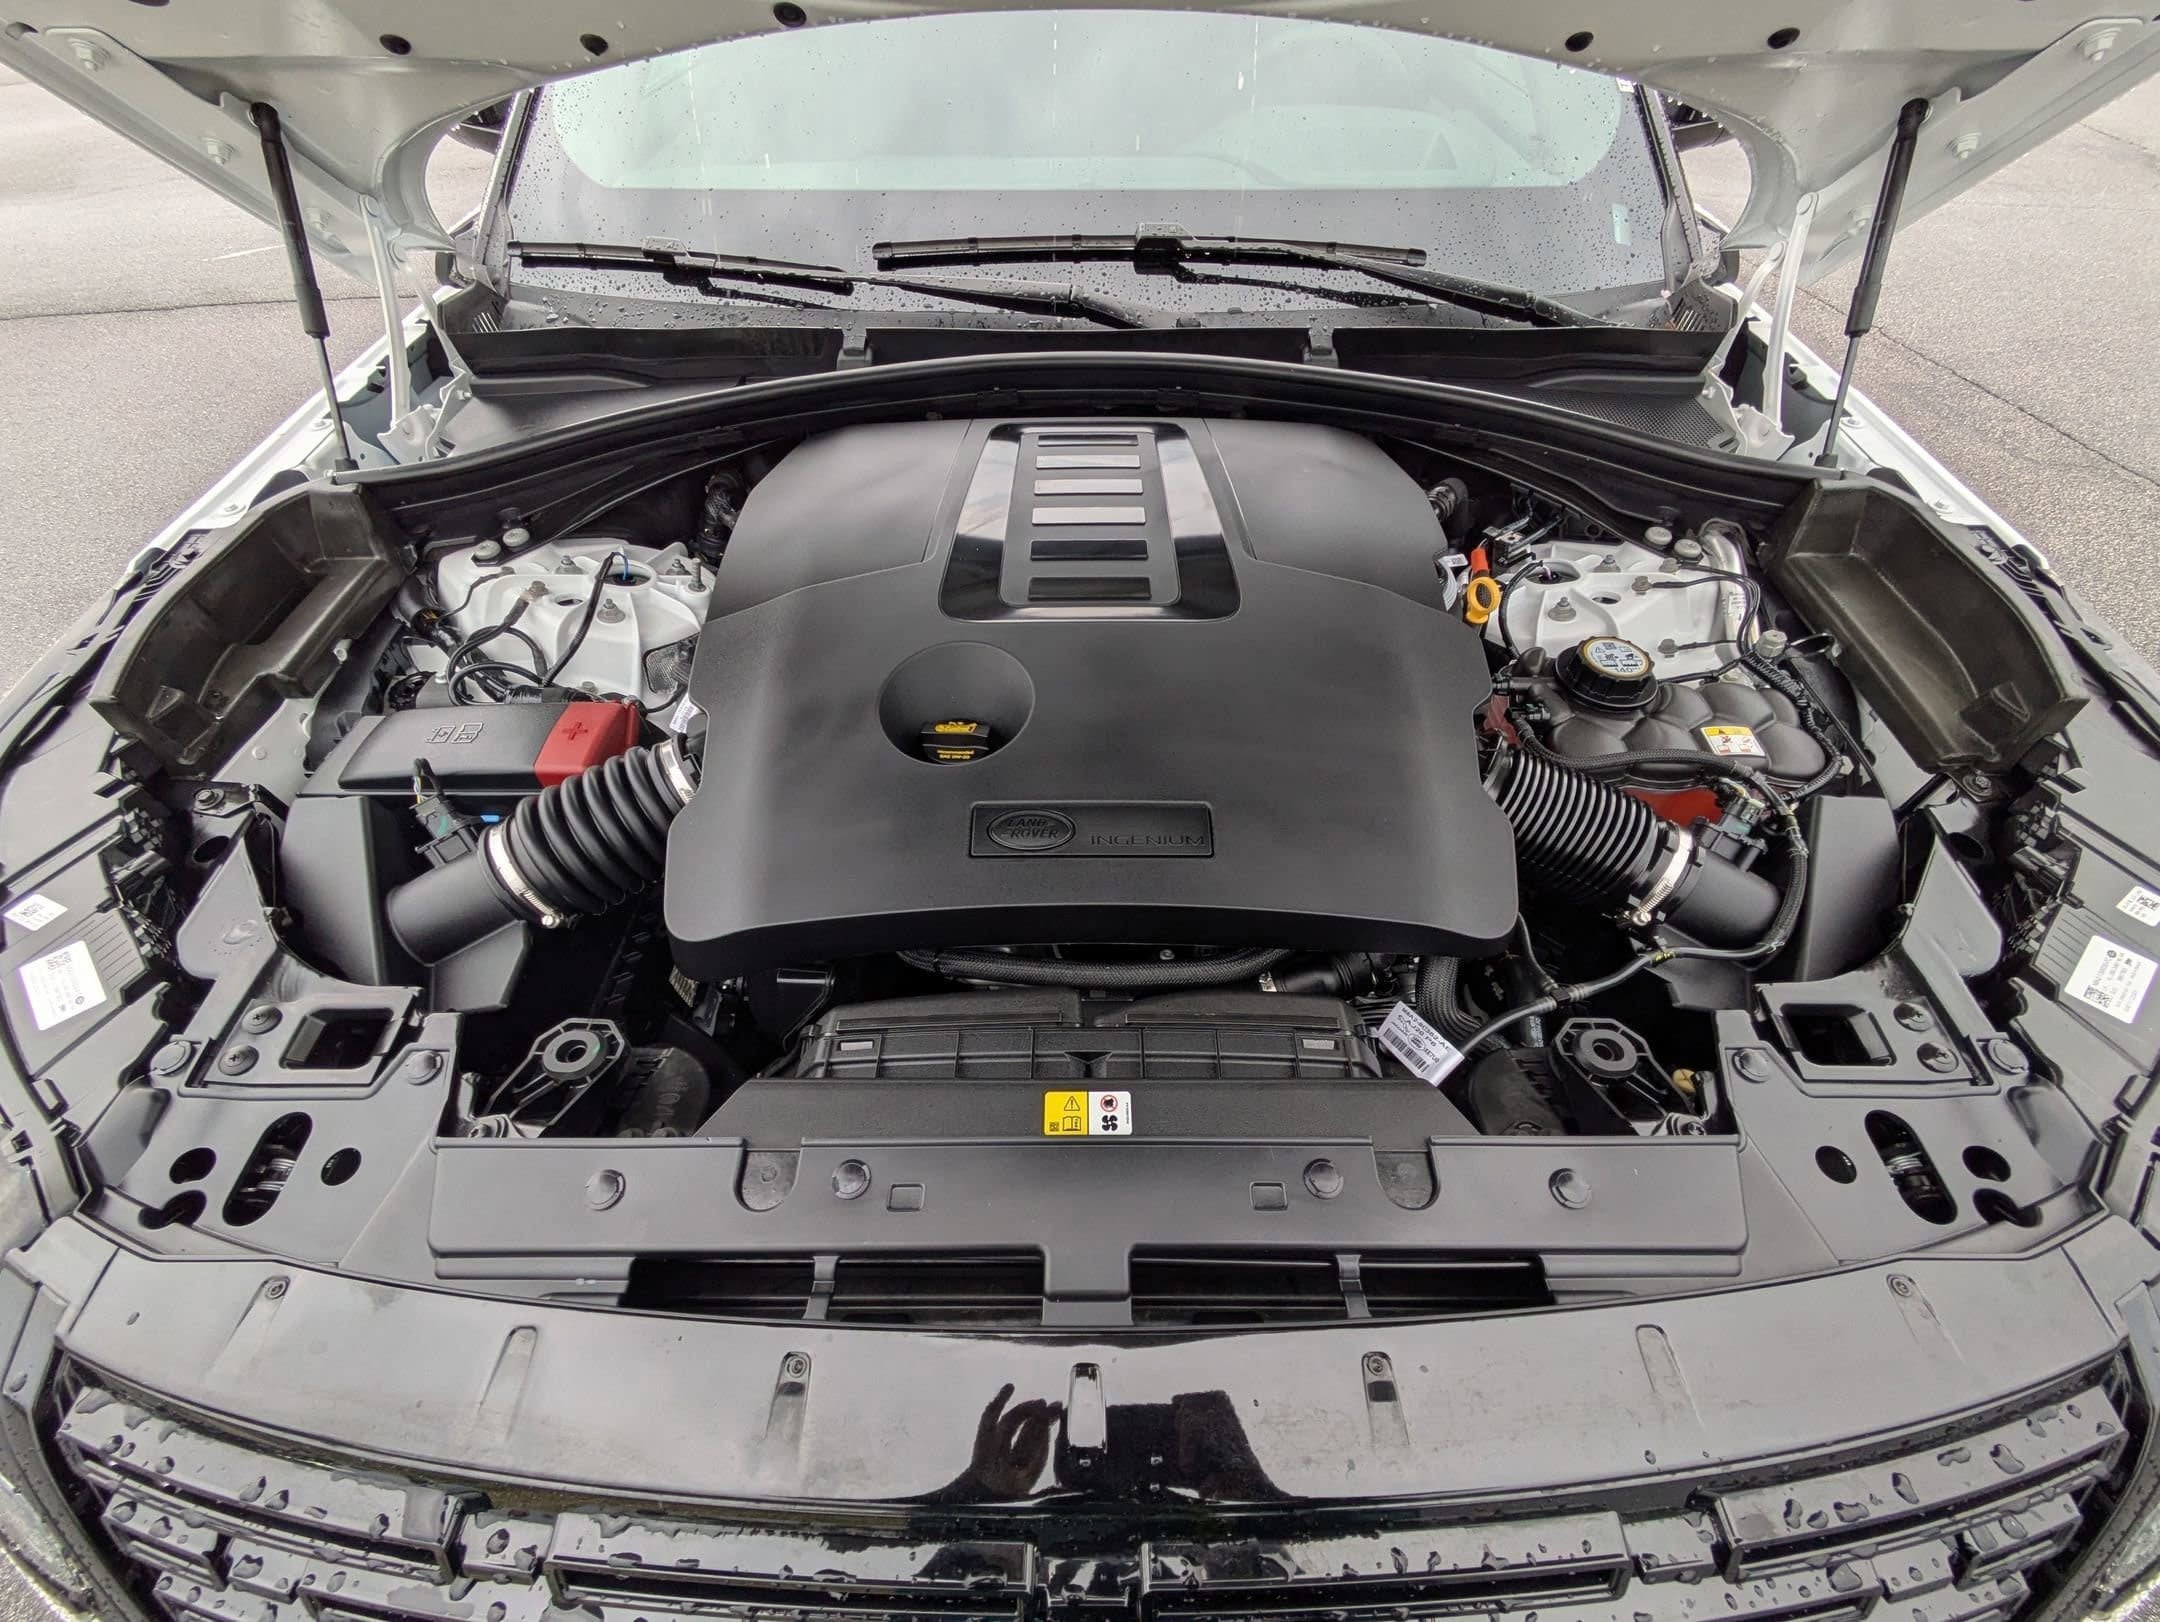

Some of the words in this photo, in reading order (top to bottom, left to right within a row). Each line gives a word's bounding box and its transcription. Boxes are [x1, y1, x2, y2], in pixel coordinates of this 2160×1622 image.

[1008, 817, 1048, 827] LAND
[1010, 827, 1058, 838] ROVER
[1091, 835, 1206, 846] INGENIUM
